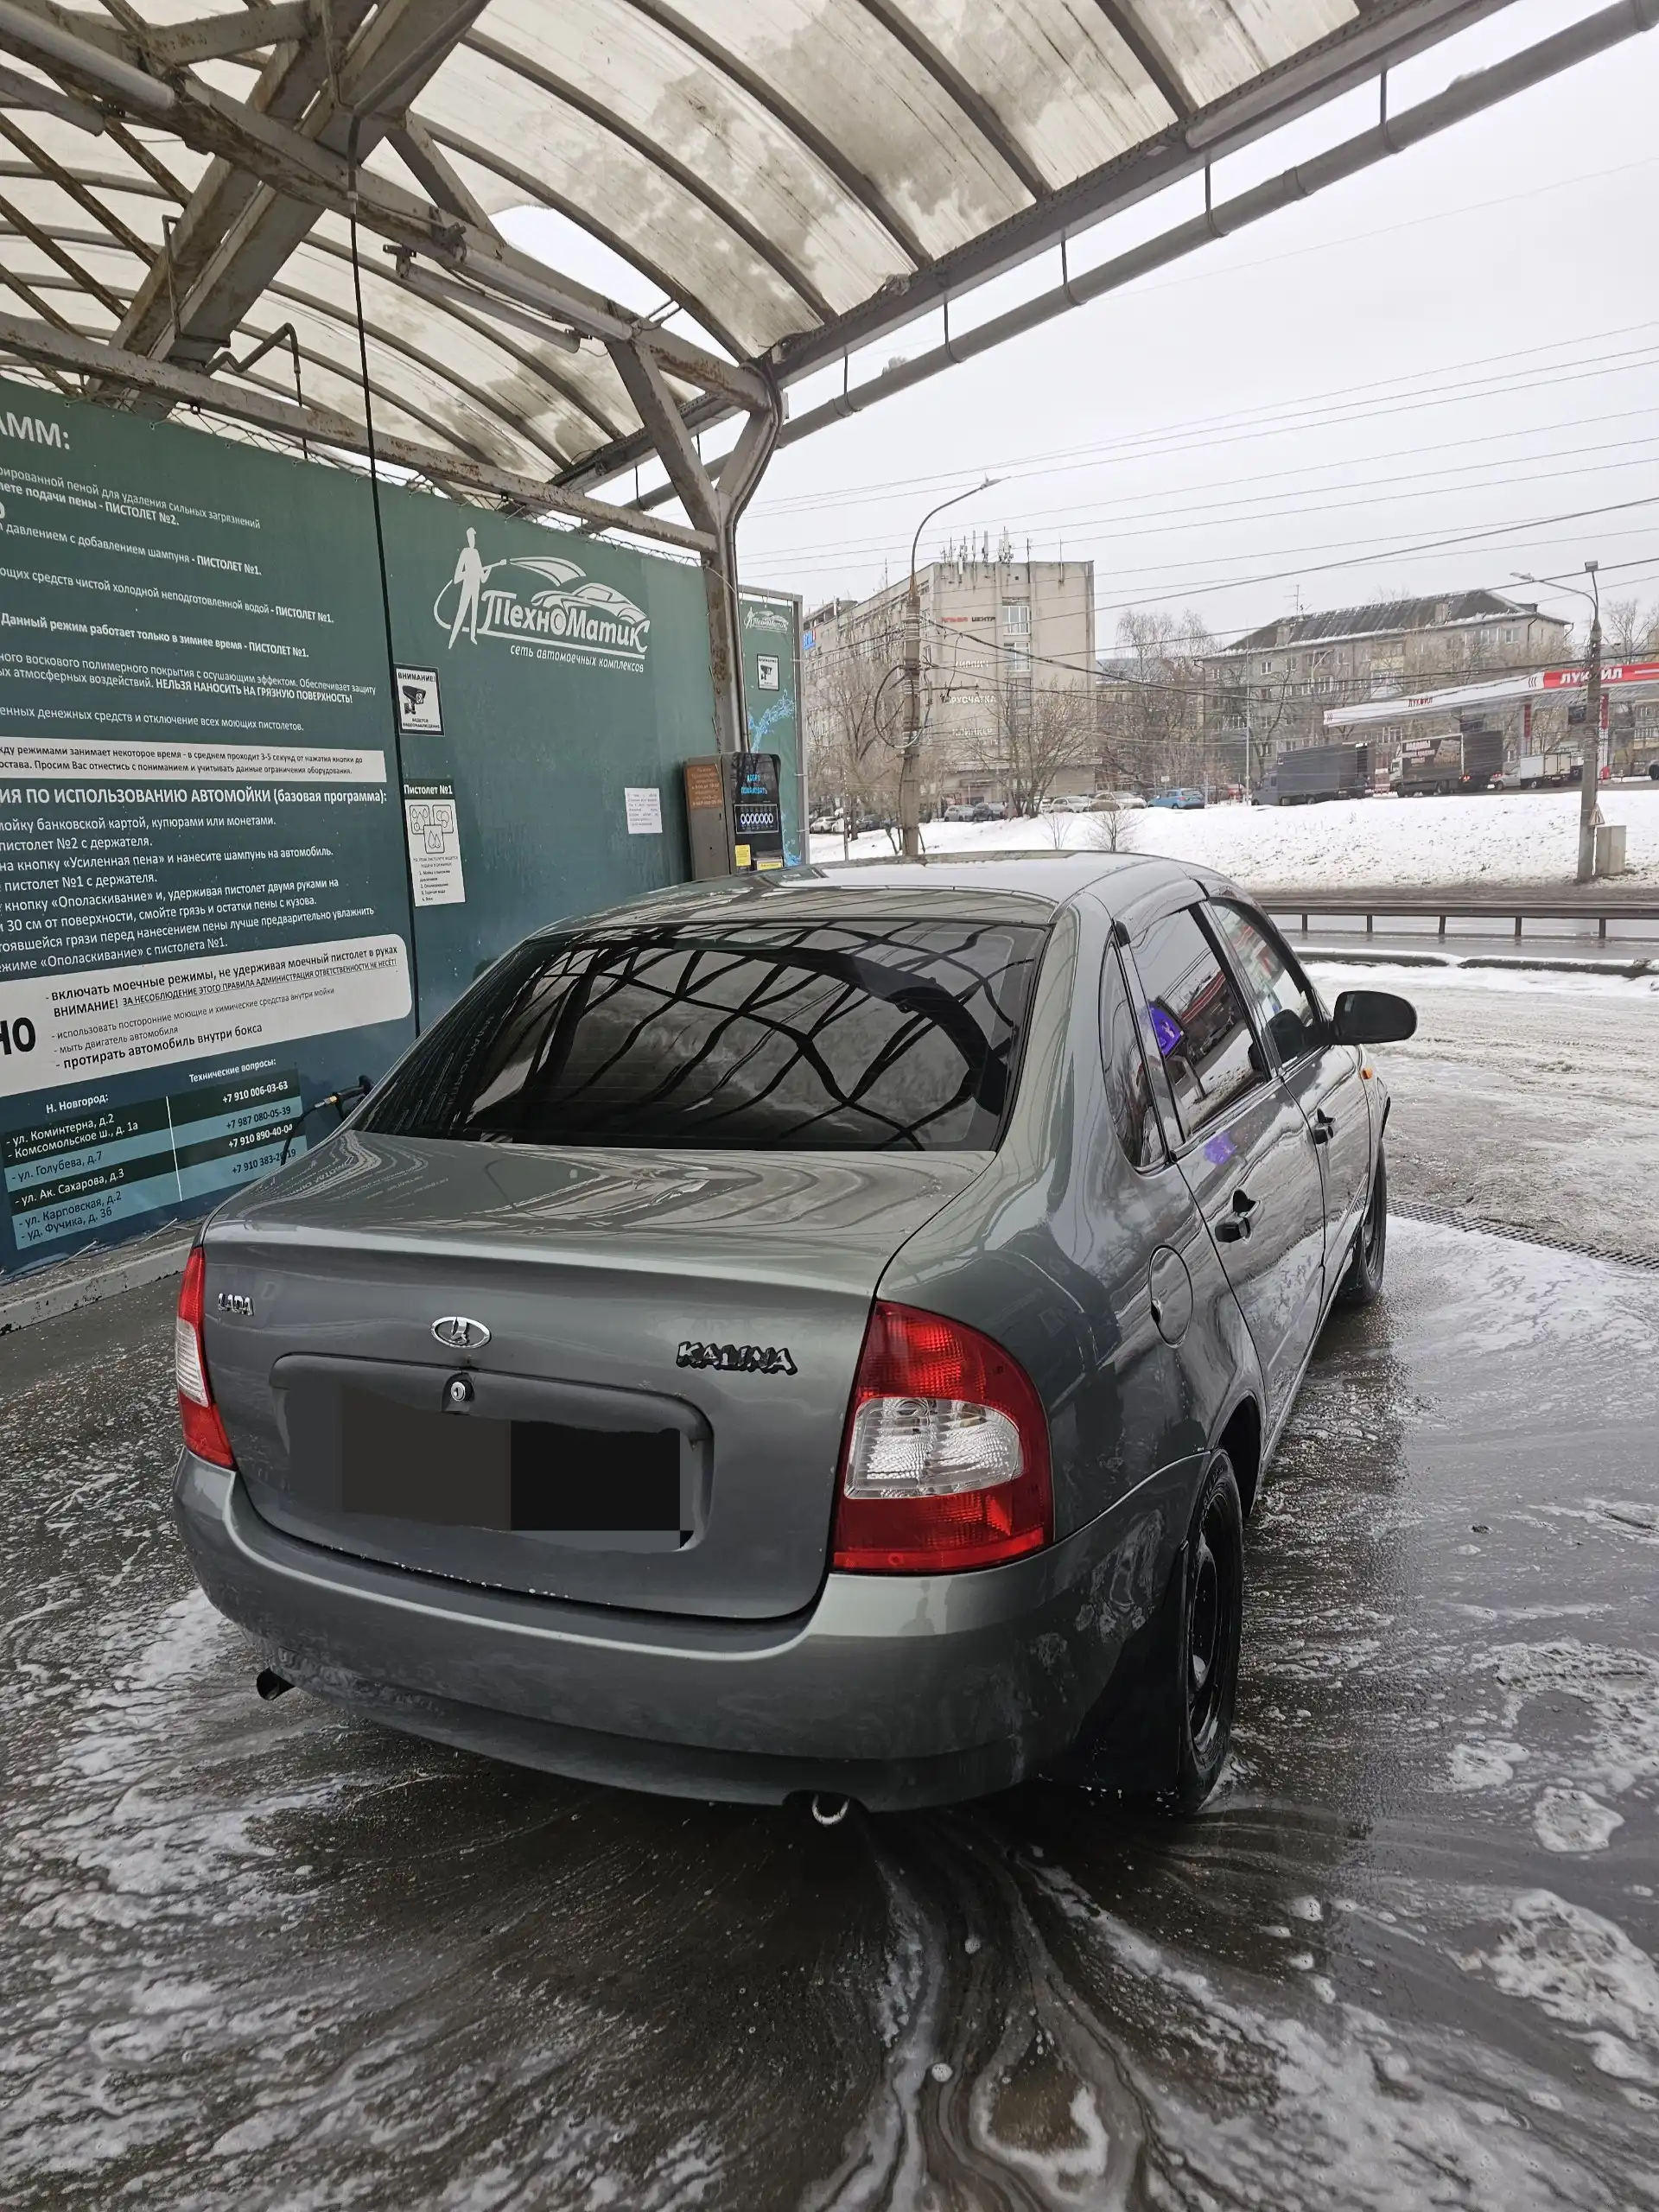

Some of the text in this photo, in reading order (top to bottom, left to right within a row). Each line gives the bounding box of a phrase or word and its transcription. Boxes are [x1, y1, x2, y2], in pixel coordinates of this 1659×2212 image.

[26, 488, 179, 525] подачи пены ПИСТОЛЕТ №2.
[6, 524, 242, 571] давлением добавлением ПИСТОЛЕТ
[33, 573, 159, 597] средств чистой холодной
[1, 613, 169, 641] Данный режим работает только
[511, 645, 644, 672] сеть автомоечных комплексов
[1560, 666, 1622, 684] ЛУКЙЛ
[156, 678, 353, 702] НЕЛЬЗЯ НАНОСИТЬ НА ГРЯЗНУЮ ПОВЕРХНОСТЬ!
[26, 789, 49, 803] ПО
[54, 789, 187, 803] ИСПОЛЬЗОВАНИЮ
[192, 786, 270, 802] АВТОМОЙКИ
[274, 789, 321, 804] (базовая
[324, 789, 386, 804] программа):
[404, 784, 453, 796] Пистолет №1
[37, 817, 105, 830] банковской
[109, 817, 149, 830] картой,
[152, 818, 204, 830] купюрами
[57, 838, 78, 849] №2
[91, 838, 152, 850] держателя.
[18, 861, 60, 871] кнопку
[64, 857, 130, 868] «Усиленная
[133, 856, 164, 865] пена»
[177, 853, 221, 862] нанесите
[224, 851, 265, 861] шампунь
[281, 846, 333, 857] автомобиль.
[5, 874, 157, 892] пистолет №1 держателя.
[5, 900, 48, 912] кнопку
[52, 893, 152, 908] «Ополаскивание»
[156, 892, 165, 901] и,
[168, 887, 222, 901] удерживая
[225, 885, 265, 894] пистолет
[268, 883, 294, 893] двумя
[297, 880, 327, 892] руками
[7, 898, 316, 931] 30 см от поверхности, смойте грязь остатки пены кузова.
[67, 908, 373, 948] грязи перед нанесением пены лучше предварительно увлажнить
[41, 938, 227, 967] «Ополаскивание» пистолета №1.
[52, 986, 110, 1001] включать
[113, 978, 164, 992] моечные
[168, 971, 216, 987] режимы,
[233, 962, 285, 977] удерживая
[289, 953, 328, 968] моечный
[331, 950, 366, 962] пистолет
[376, 947, 397, 957] руках
[54, 963, 371, 1017] ВНИМАНИЕ! ЗА НЕСОБЛЮДЕНИЕ ЭТОГО ПРАВИЛА АДМИНИСТРАЦИЯ ОТВЕТСТВЕННОСТИ
[60, 1027, 178, 1053] мыть двигатель автомобиля
[64, 1025, 262, 1070] протирать автомобиль внутри бокса
[189, 1058, 276, 1082] Технические вопросы:
[47, 1094, 109, 1114] Н. Новгород:
[223, 1081, 288, 1103] +7 910 006-03-63
[12, 1113, 114, 1147] ул. Коминтерна, д.2
[226, 1106, 290, 1128] +7 987 080-05-39
[15, 1122, 138, 1158] Комсомольское ш., д. 1а
[228, 1138, 238, 1147] +7
[240, 1134, 254, 1146] 910
[17, 1151, 102, 1182] ул. Голубева, д.7
[232, 1160, 257, 1173] +7 910
[22, 1168, 124, 1206] ул. Ак. Сахарова, д.3
[25, 1191, 122, 1227] ул. Карповская, д.2
[45, 1217, 86, 1234] Фучика,
[101, 1208, 112, 1218] 36
[677, 1341, 798, 1376] KALINA
